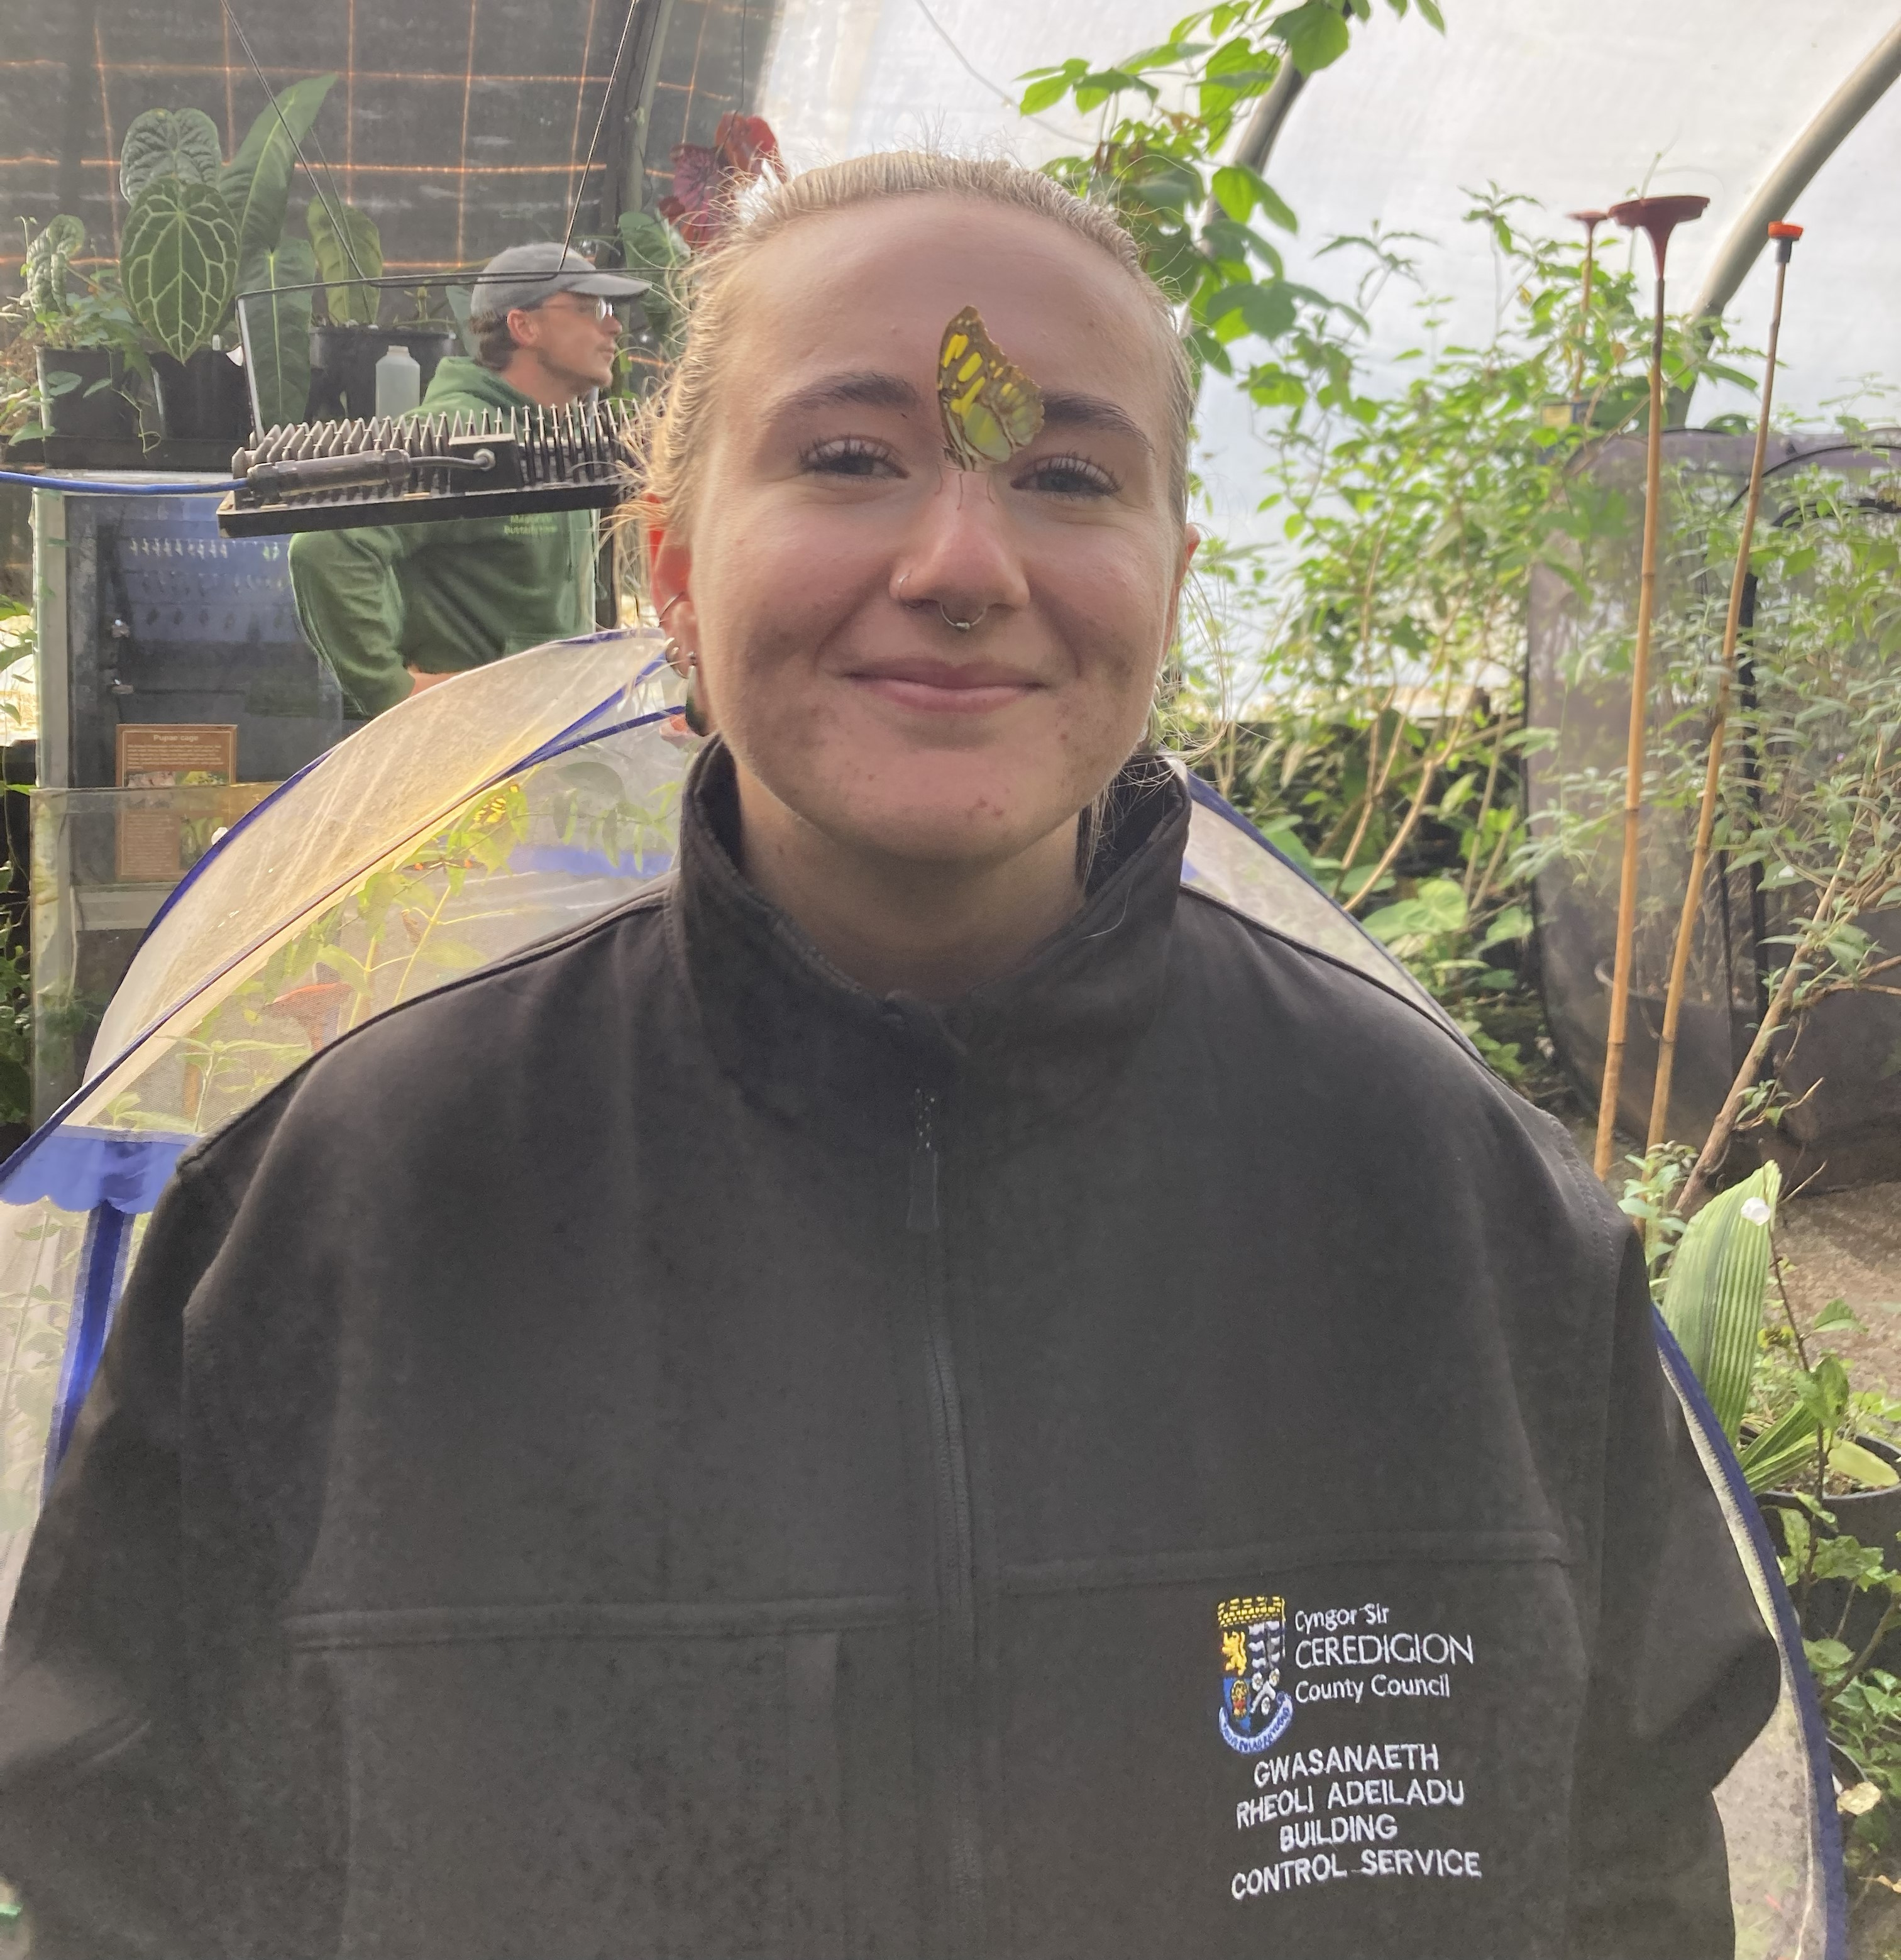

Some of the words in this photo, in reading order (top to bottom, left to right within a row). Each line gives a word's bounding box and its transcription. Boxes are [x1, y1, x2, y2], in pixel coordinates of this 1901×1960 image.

[1295, 1609, 1357, 1634] Cyngor
[1365, 1603, 1389, 1624] Sir
[1295, 1632, 1474, 1669] CEREDIGION
[1295, 1678, 1364, 1703] County
[1371, 1673, 1450, 1697] Council
[1254, 1743, 1439, 1788] GWASANAETH
[1236, 1785, 1314, 1830] RHEOLI
[1327, 1778, 1465, 1809] ADEILADU
[1279, 1814, 1398, 1853] BUILDING
[1231, 1853, 1347, 1900] CONTROL
[1360, 1849, 1482, 1878] SERVICE
